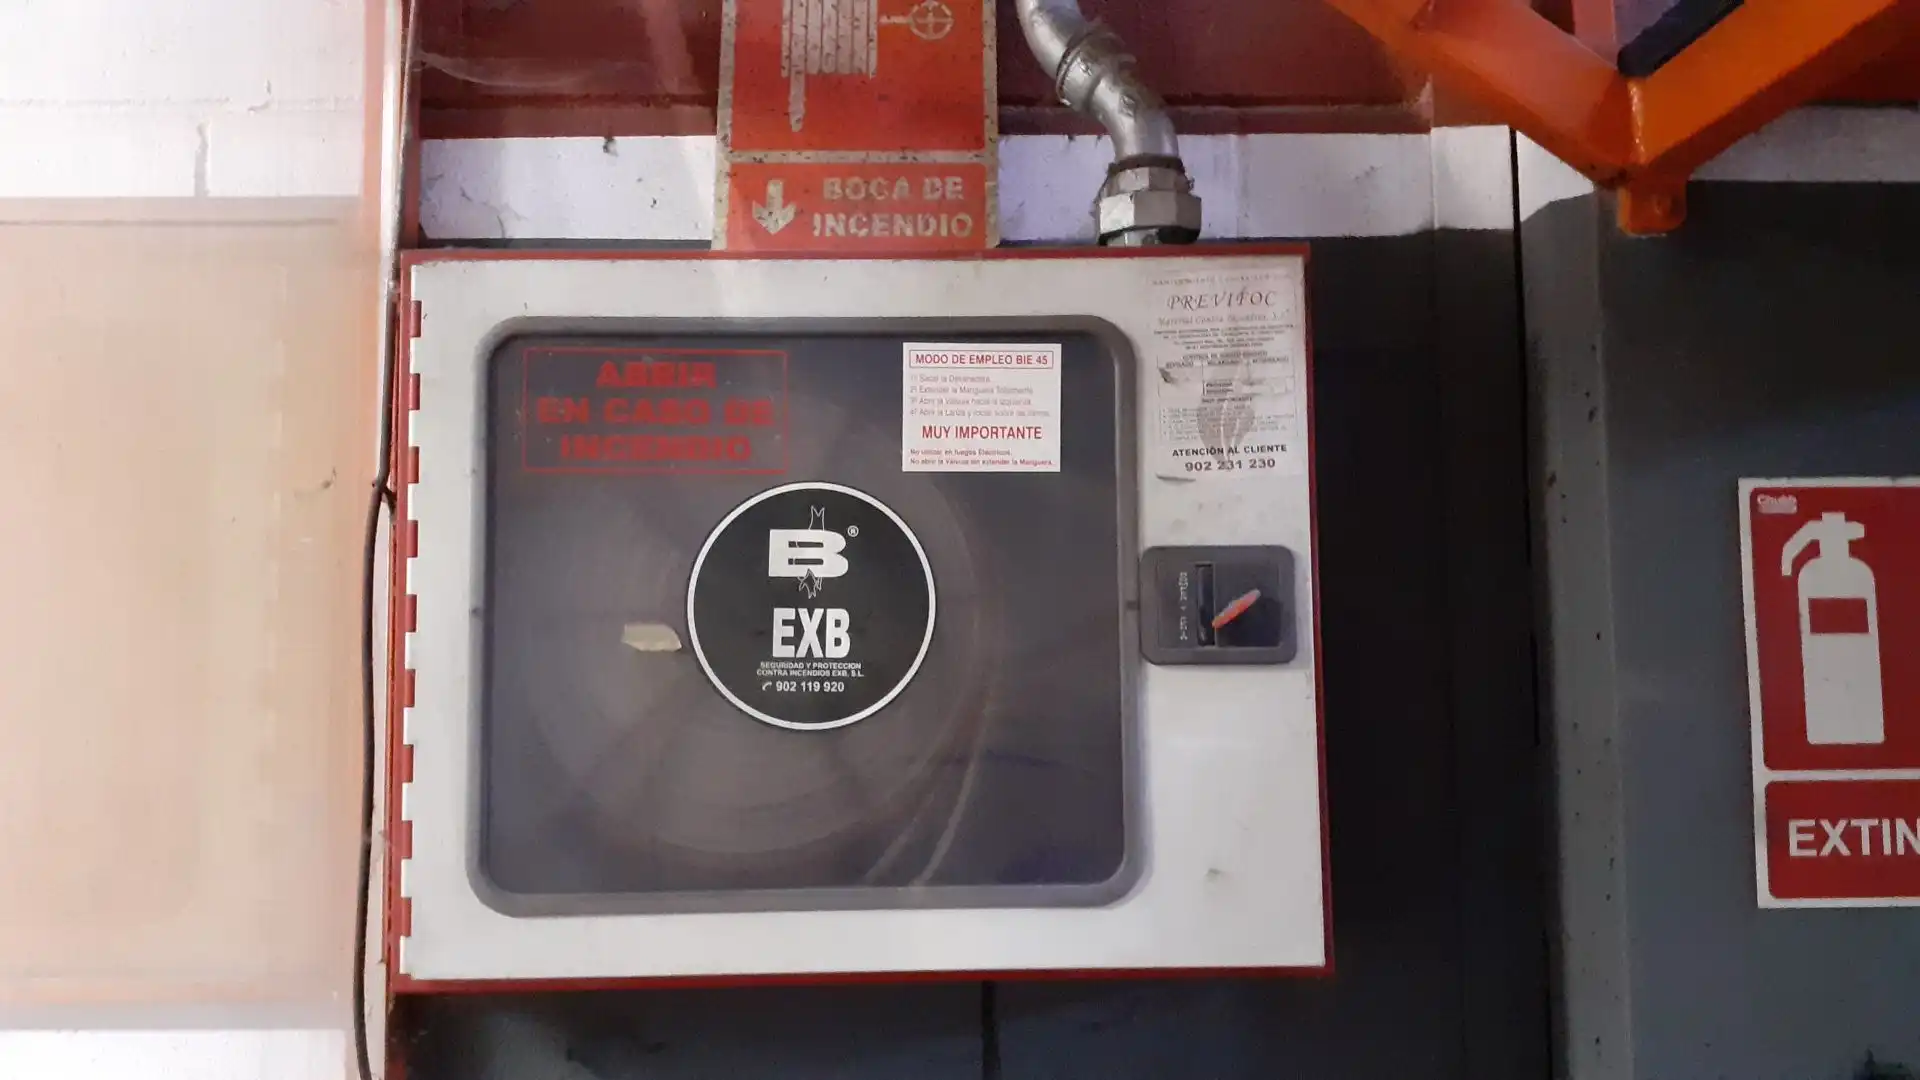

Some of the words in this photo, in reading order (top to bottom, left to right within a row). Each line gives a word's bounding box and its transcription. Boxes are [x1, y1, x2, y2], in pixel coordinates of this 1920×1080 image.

[823, 177, 910, 201] BOCA
[923, 177, 964, 201] DE
[812, 212, 973, 237] INCENDIO
[1167, 286, 1277, 313] PREVIFOC
[915, 353, 949, 365] MODO
[951, 354, 967, 365] DE
[969, 354, 1013, 365] EMPLEO
[1015, 355, 1033, 365] BIE
[1035, 355, 1048, 365] 45
[596, 361, 717, 389] ABRIR
[536, 397, 590, 424] EN
[603, 398, 711, 425] CASO
[724, 400, 775, 426] DE
[922, 425, 951, 439] MUY
[955, 426, 1043, 440] IMPORTANTE
[560, 434, 752, 461] INCENDIO
[954, 448, 977, 457] fuegos
[1172, 444, 1224, 457] ATENCIÓN
[1227, 446, 1240, 455] AL
[1244, 443, 1288, 454] CLIENTE
[1185, 461, 1212, 472] 902
[1217, 460, 1243, 472] 231
[1249, 459, 1277, 470] 230
[772, 607, 851, 659] EXB
[756, 669, 788, 677] CONTRA
[789, 669, 830, 677] INCENDIOS
[760, 661, 804, 669] SEGURIDAD
[805, 661, 812, 669] Y
[776, 681, 797, 692] 902
[801, 681, 821, 692] 119
[823, 681, 845, 692] 920
[1788, 818, 1920, 857] EXTIN
